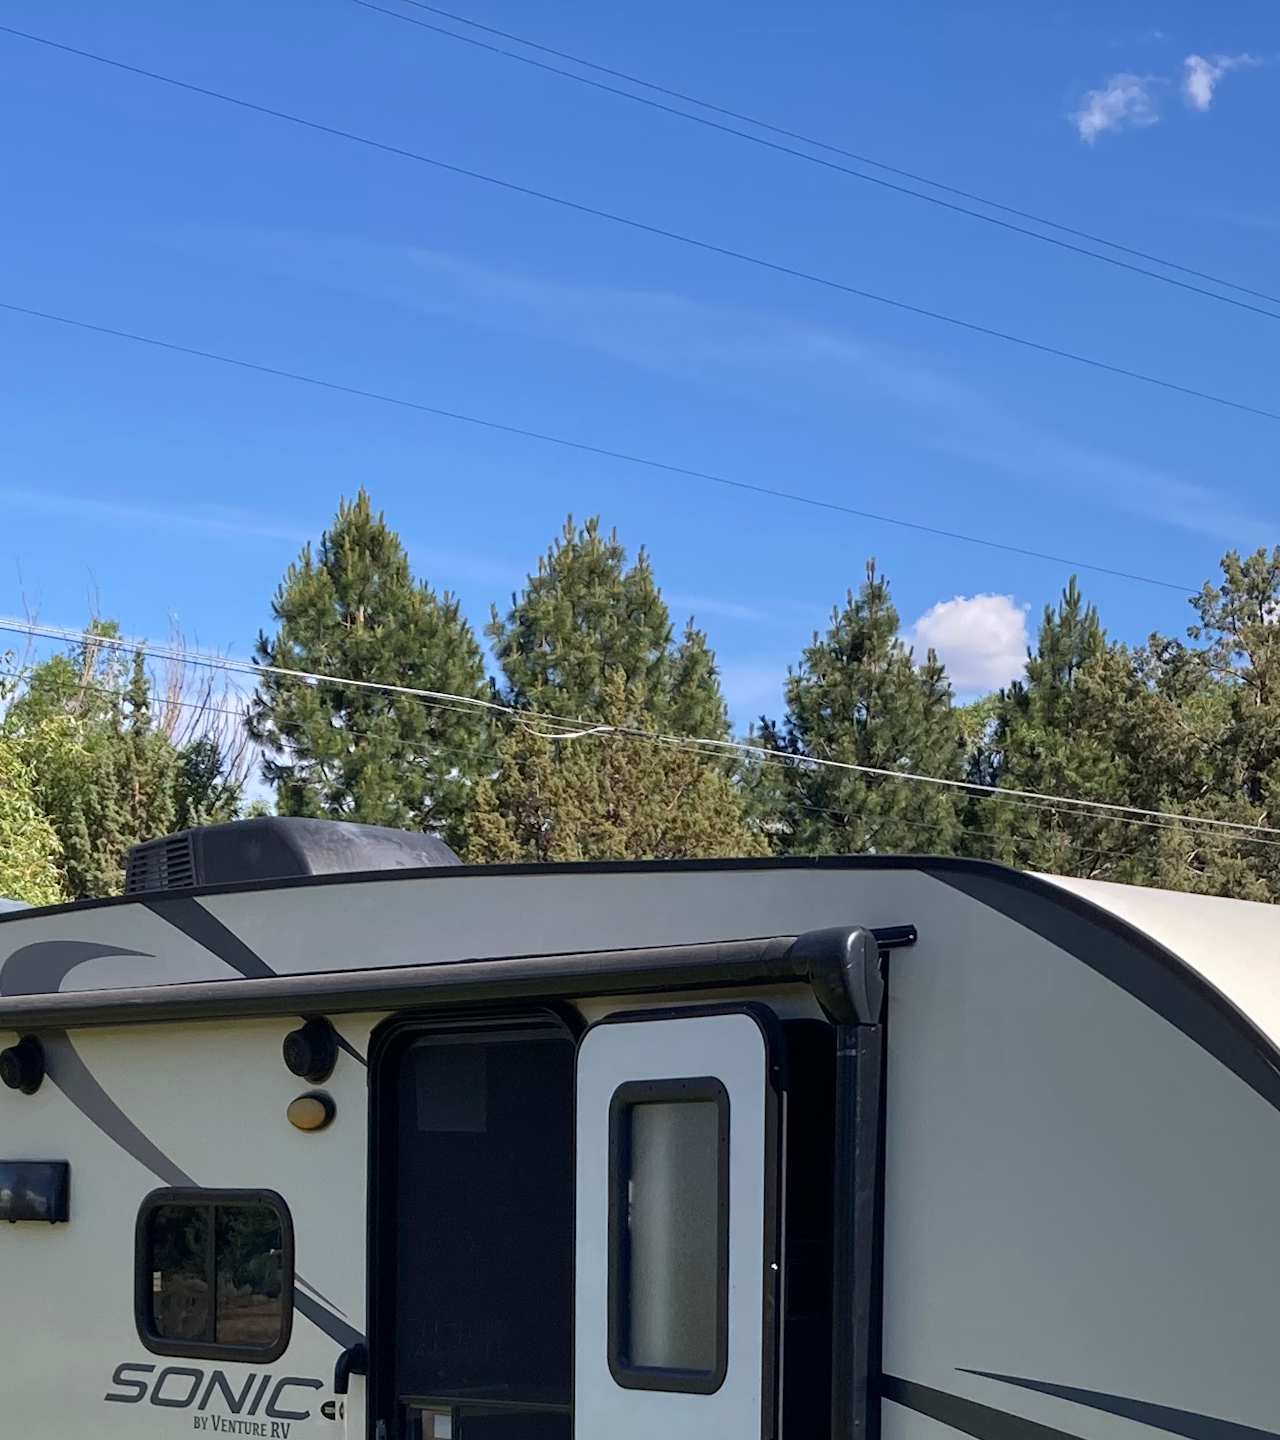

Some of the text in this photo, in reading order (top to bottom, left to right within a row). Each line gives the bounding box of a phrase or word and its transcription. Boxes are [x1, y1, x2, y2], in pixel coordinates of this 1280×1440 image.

[103, 1362, 324, 1421] SONIC
[193, 1414, 291, 1440] BY VENTURE RV
